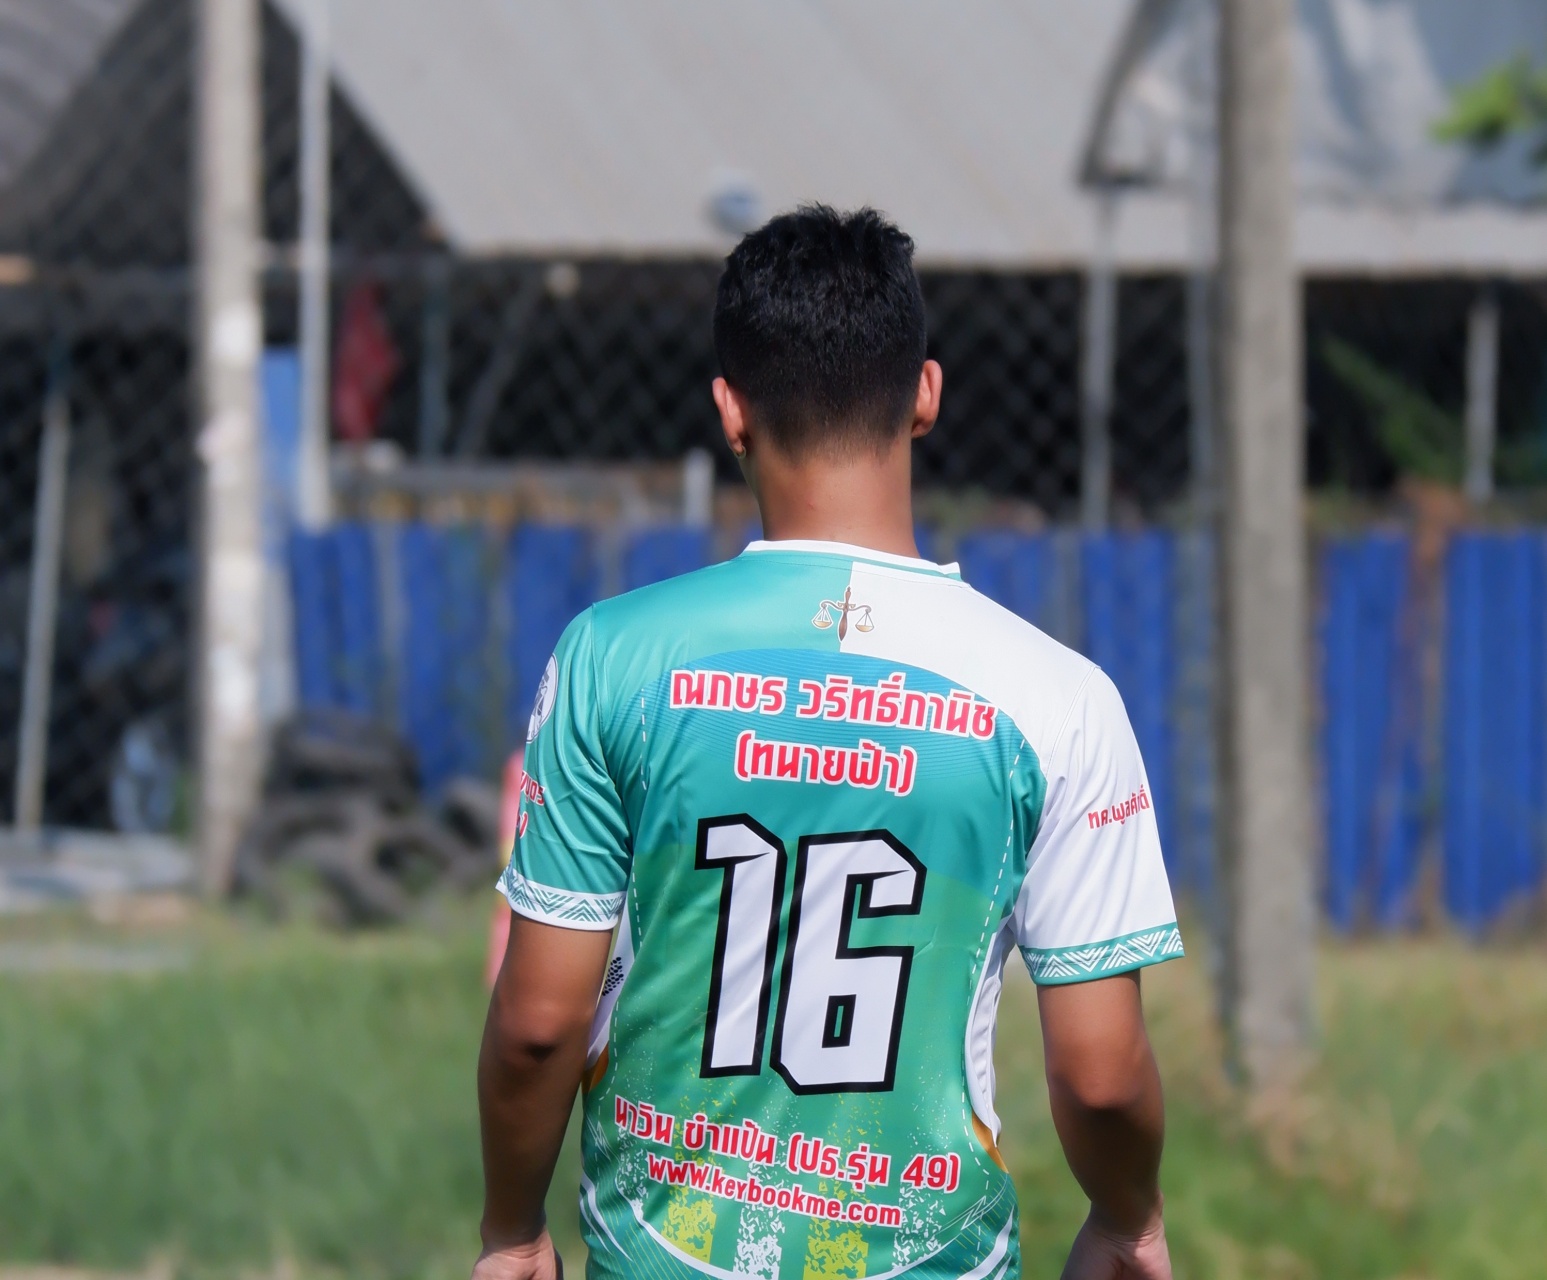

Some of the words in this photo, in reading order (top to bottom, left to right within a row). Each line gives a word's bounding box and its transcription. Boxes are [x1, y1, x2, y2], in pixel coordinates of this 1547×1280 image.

[735, 731, 917, 796] (ทนายฟ้า)
[695, 813, 927, 1095] 16
[615, 1095, 674, 1146] นาวิน
[902, 1152, 961, 1194] 49)
[647, 1153, 902, 1227] www.keybookme.com
